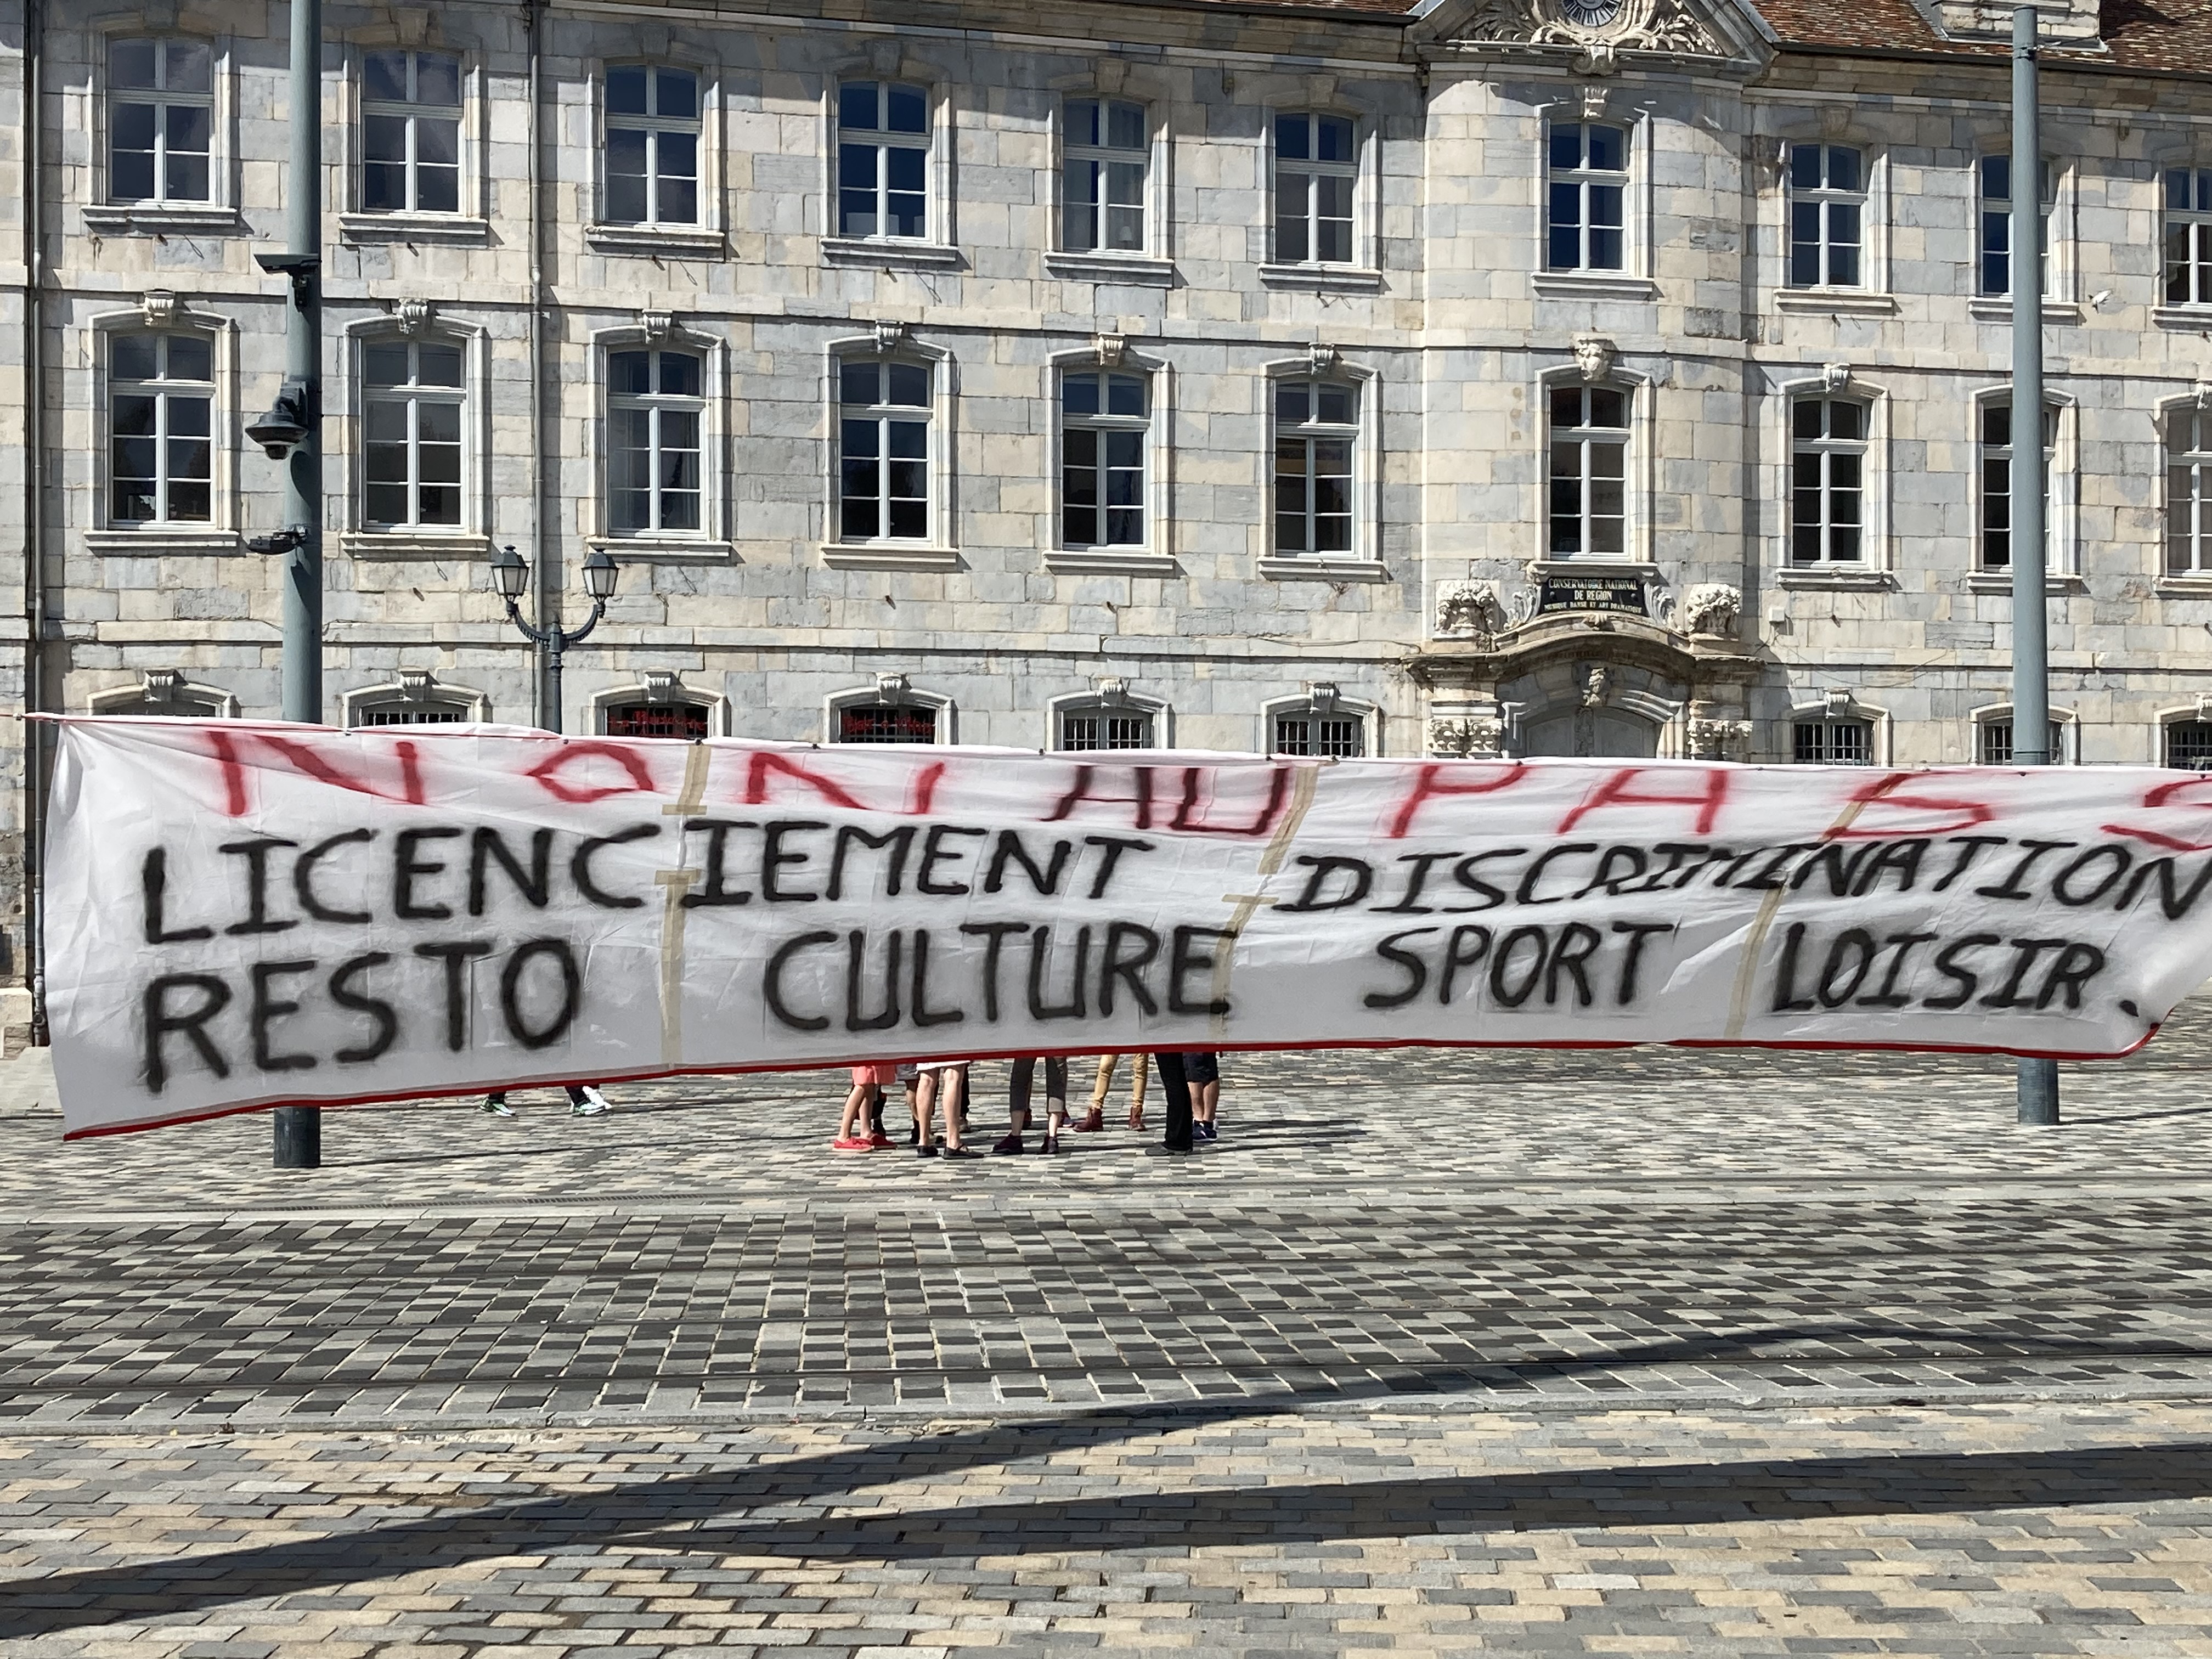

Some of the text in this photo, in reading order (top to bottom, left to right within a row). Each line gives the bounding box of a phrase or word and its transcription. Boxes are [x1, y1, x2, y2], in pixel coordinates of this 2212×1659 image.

[1574, 590, 1612, 601] DE REGION
[1605, 579, 1638, 590] NATIONAL
[142, 820, 2212, 945] LICENCIEMENT DISCRIMINATION
[142, 937, 580, 1094] RESTO
[765, 921, 1238, 1031] CULTURE
[1363, 921, 1675, 1008] SPORT
